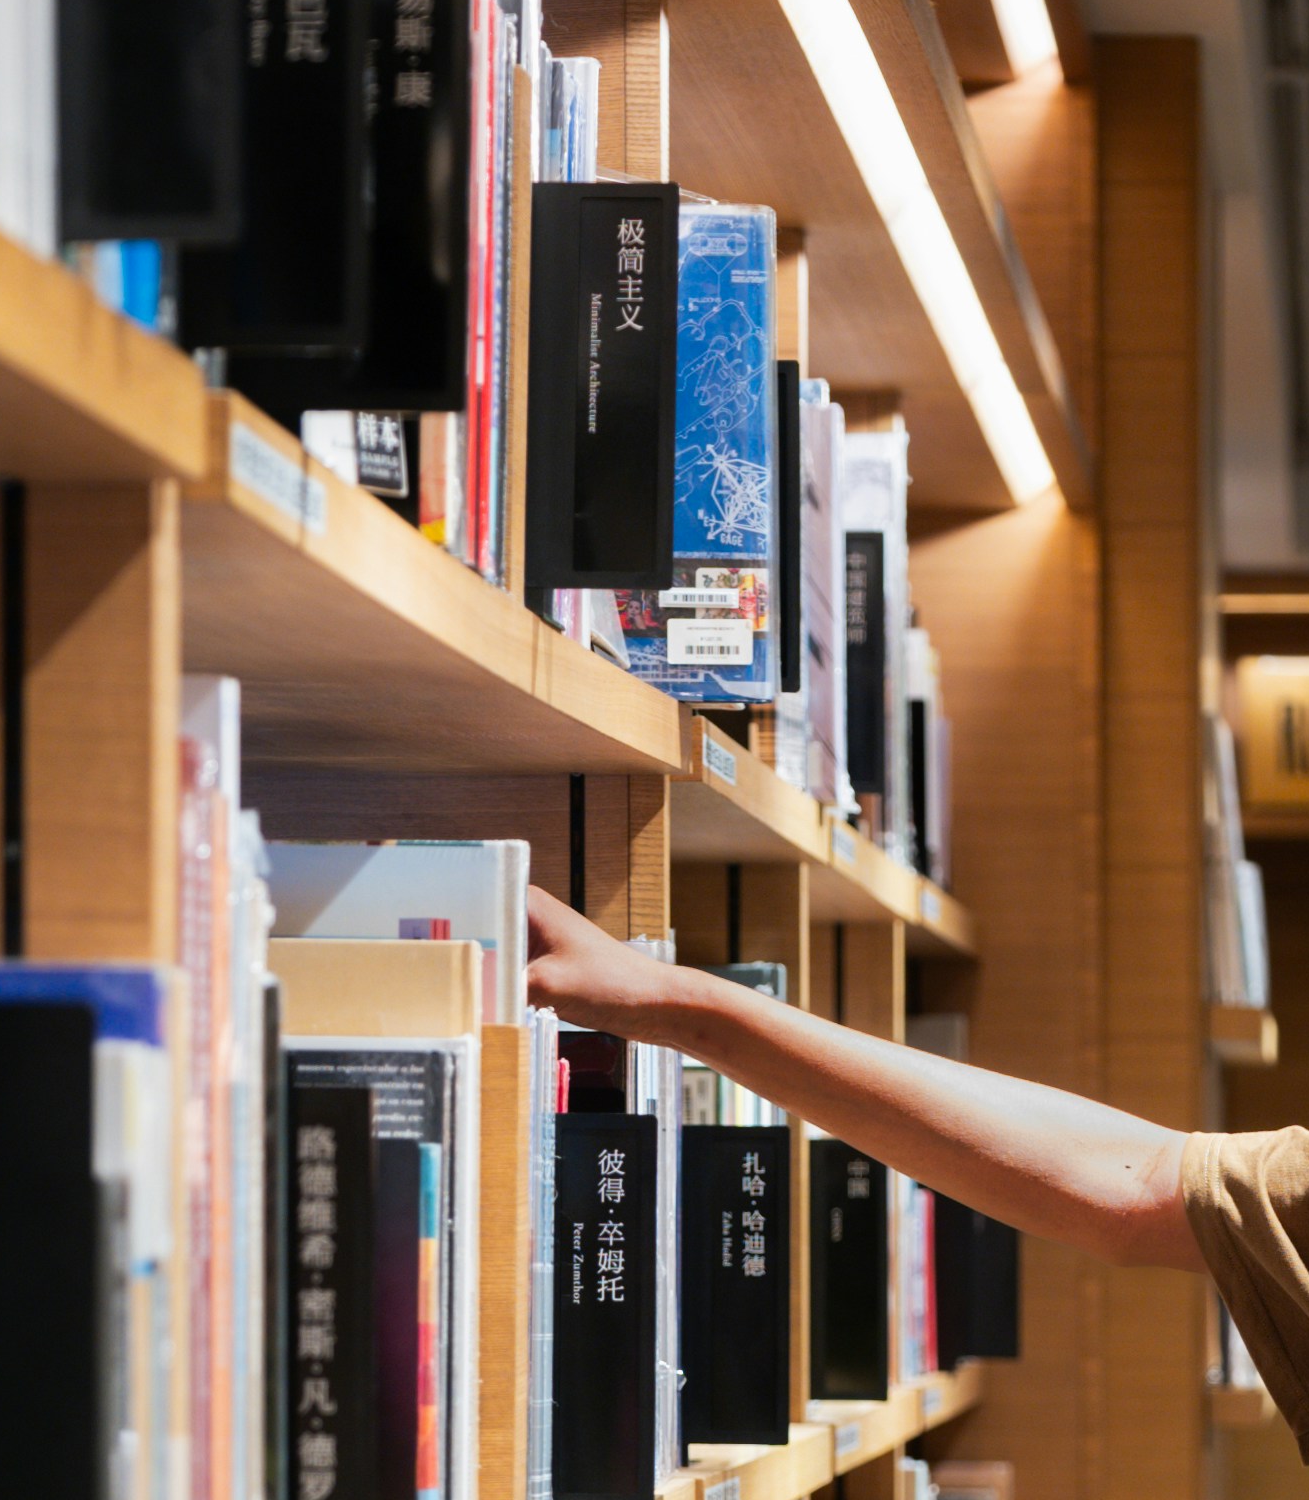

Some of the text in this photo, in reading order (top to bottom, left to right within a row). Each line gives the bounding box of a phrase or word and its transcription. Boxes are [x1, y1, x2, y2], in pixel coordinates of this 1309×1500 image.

[615, 218, 645, 331] 极简主义
[588, 293, 602, 434] Minimalist Architecture
[597, 1149, 625, 1302] 彼得·卒姆托
[741, 1152, 766, 1277] 扎哈·哈迪德
[847, 1159, 869, 1199] 中国
[573, 1222, 584, 1304] Peter Zumthor
